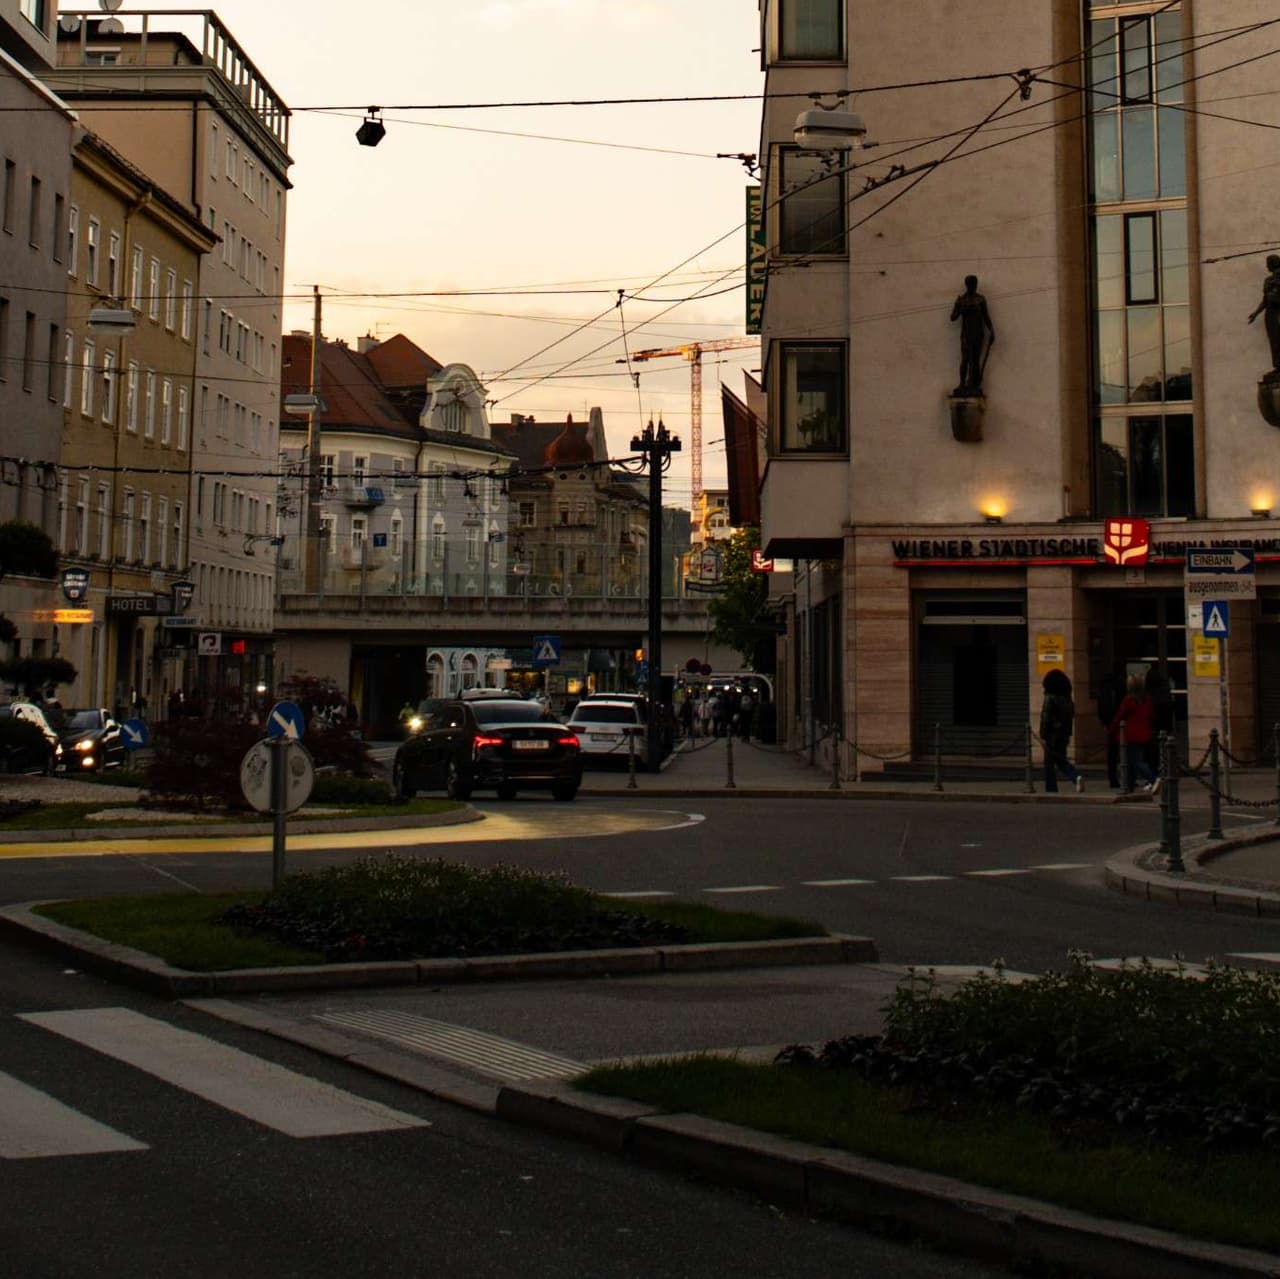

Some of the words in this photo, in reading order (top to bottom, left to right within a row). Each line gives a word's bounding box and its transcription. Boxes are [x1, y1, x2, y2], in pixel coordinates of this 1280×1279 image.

[892, 540, 974, 559] WIENER
[978, 538, 1099, 557] STÄDTISCHE
[1151, 540, 1207, 554] VIENNA
[1193, 555, 1232, 566] EINBAHN
[1188, 581, 1239, 596] ausgenommen
[111, 599, 153, 612] HOTEL
